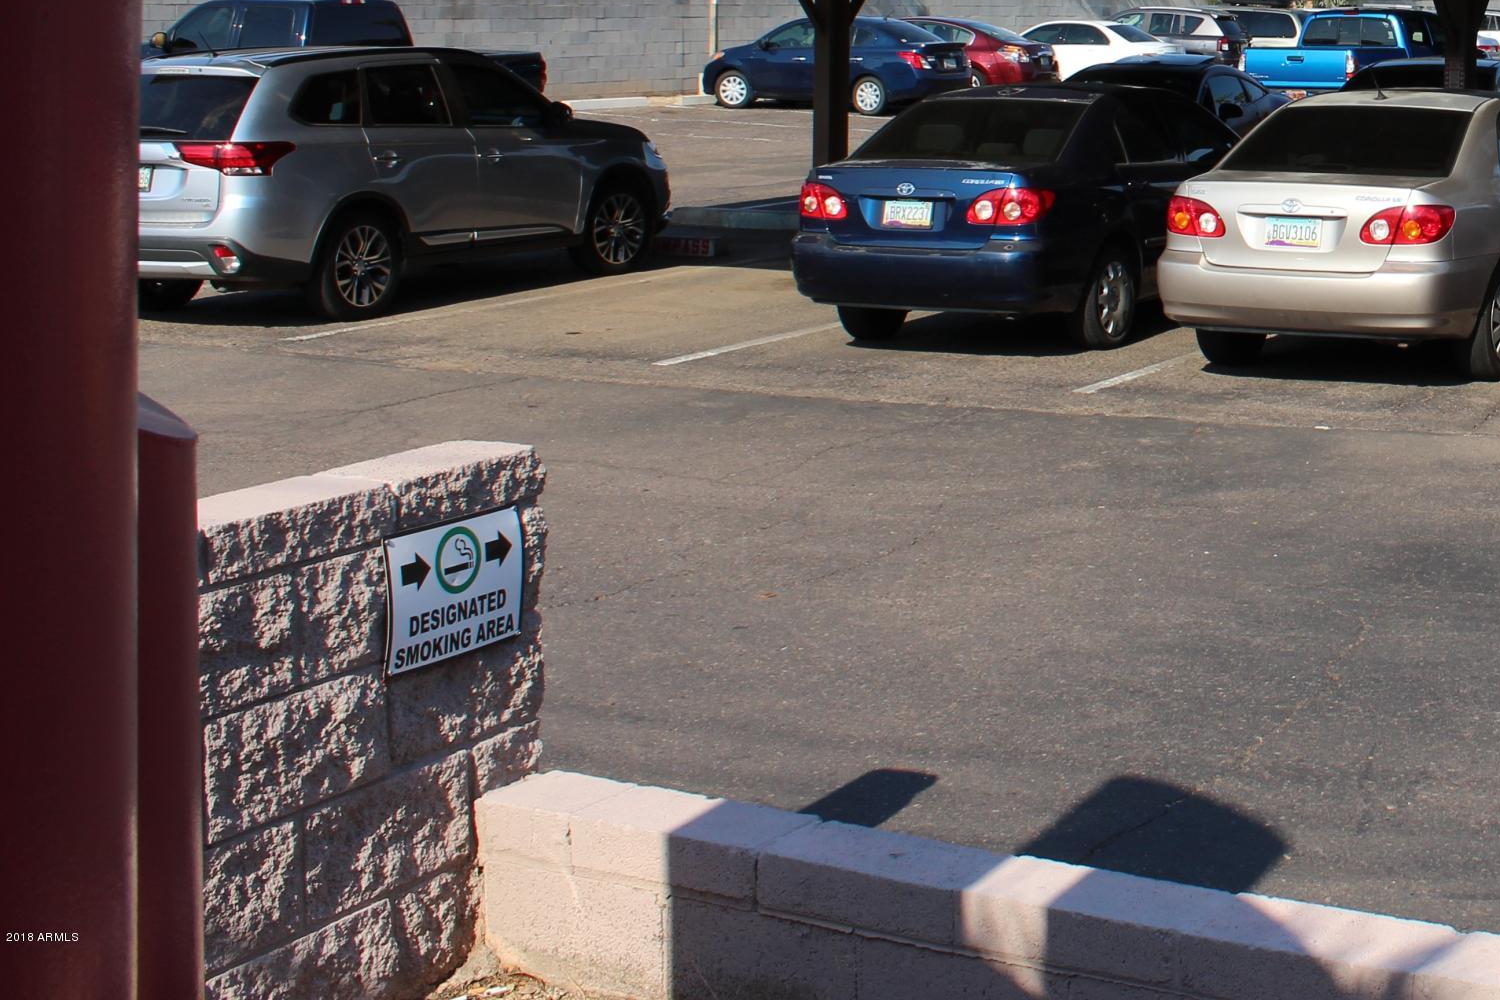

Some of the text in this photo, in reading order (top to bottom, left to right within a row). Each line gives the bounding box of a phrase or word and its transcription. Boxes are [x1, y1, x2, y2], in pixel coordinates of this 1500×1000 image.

[889, 205, 930, 220] BRX2237
[1272, 223, 1318, 241] BGV3106
[409, 588, 507, 638] DESIGNATED
[394, 613, 515, 669] SMOKING AREA
